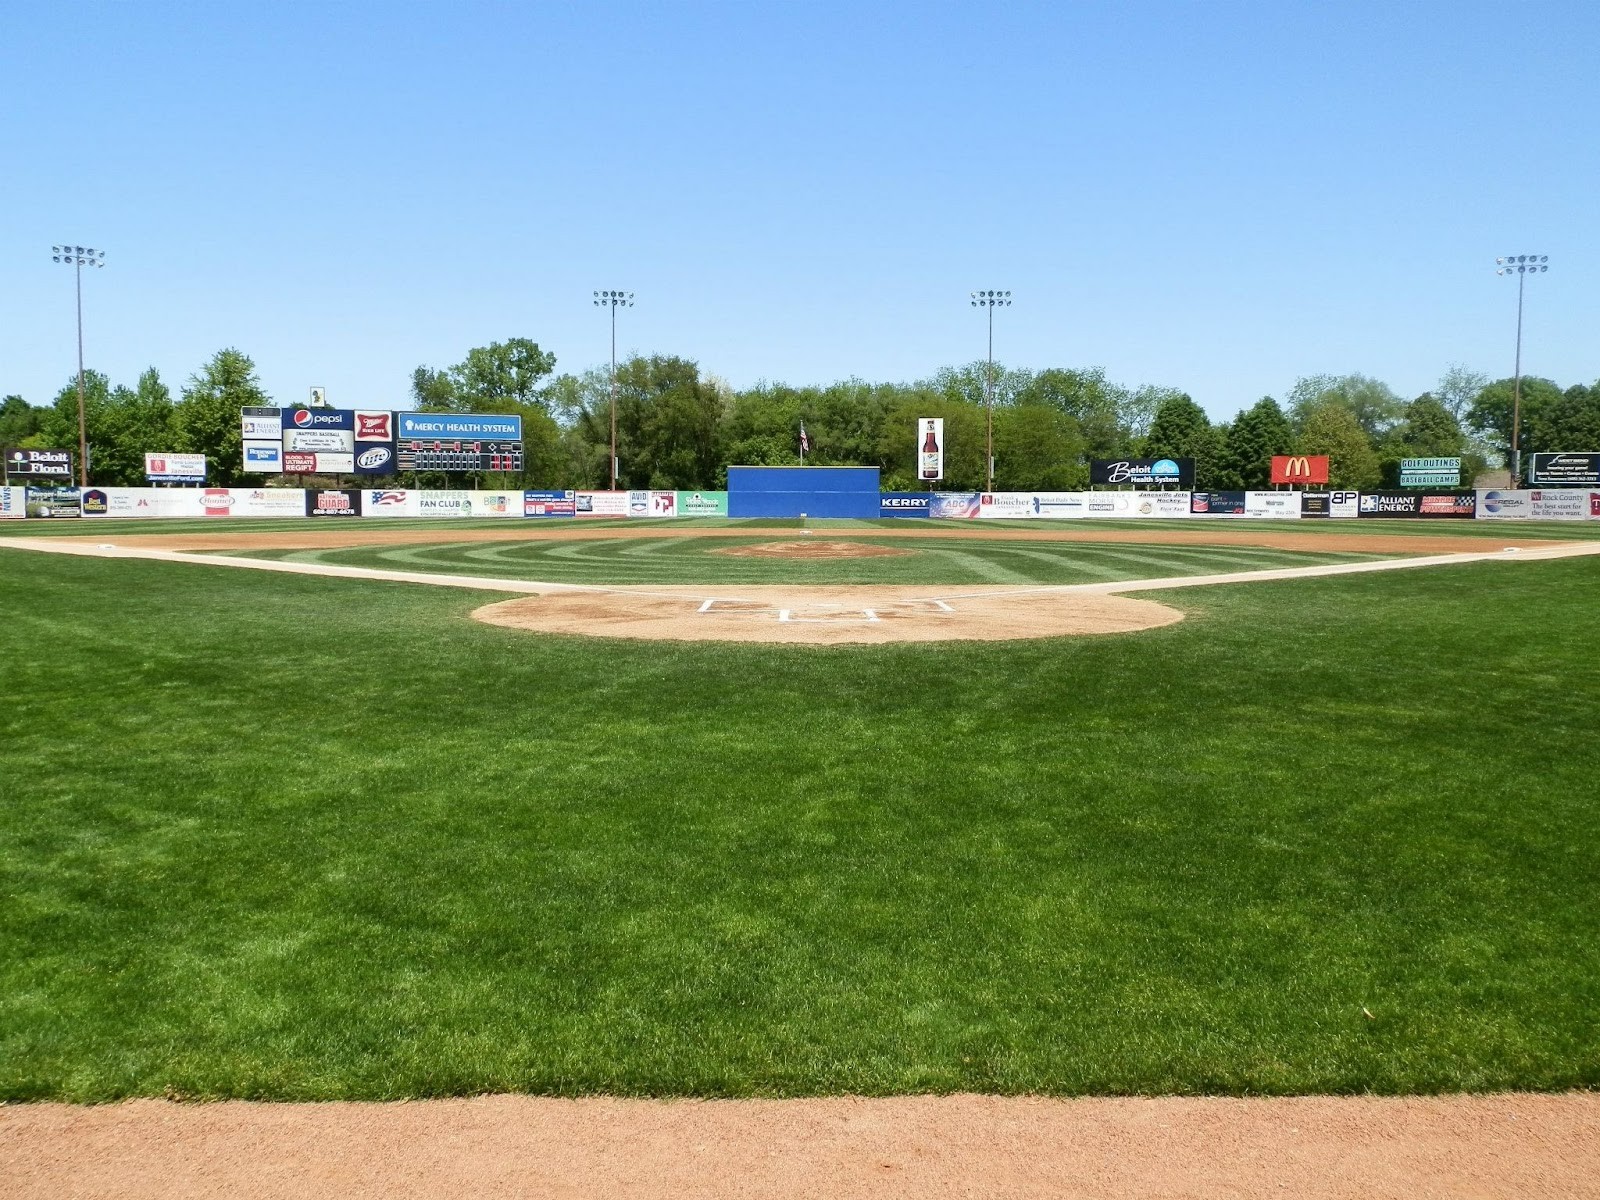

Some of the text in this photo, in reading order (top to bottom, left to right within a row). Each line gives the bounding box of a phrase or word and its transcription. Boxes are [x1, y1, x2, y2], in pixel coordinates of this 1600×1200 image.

[314, 415, 343, 424] pepsi
[414, 423, 515, 433] MERCY HEALTH SYSTEM
[29, 451, 69, 461] Beloit
[30, 463, 69, 473] Floral
[1107, 461, 1151, 483] Beloit
[1154, 476, 1179, 484] System
[319, 500, 349, 508] GUARD
[1379, 496, 1416, 504] ALLIANT
